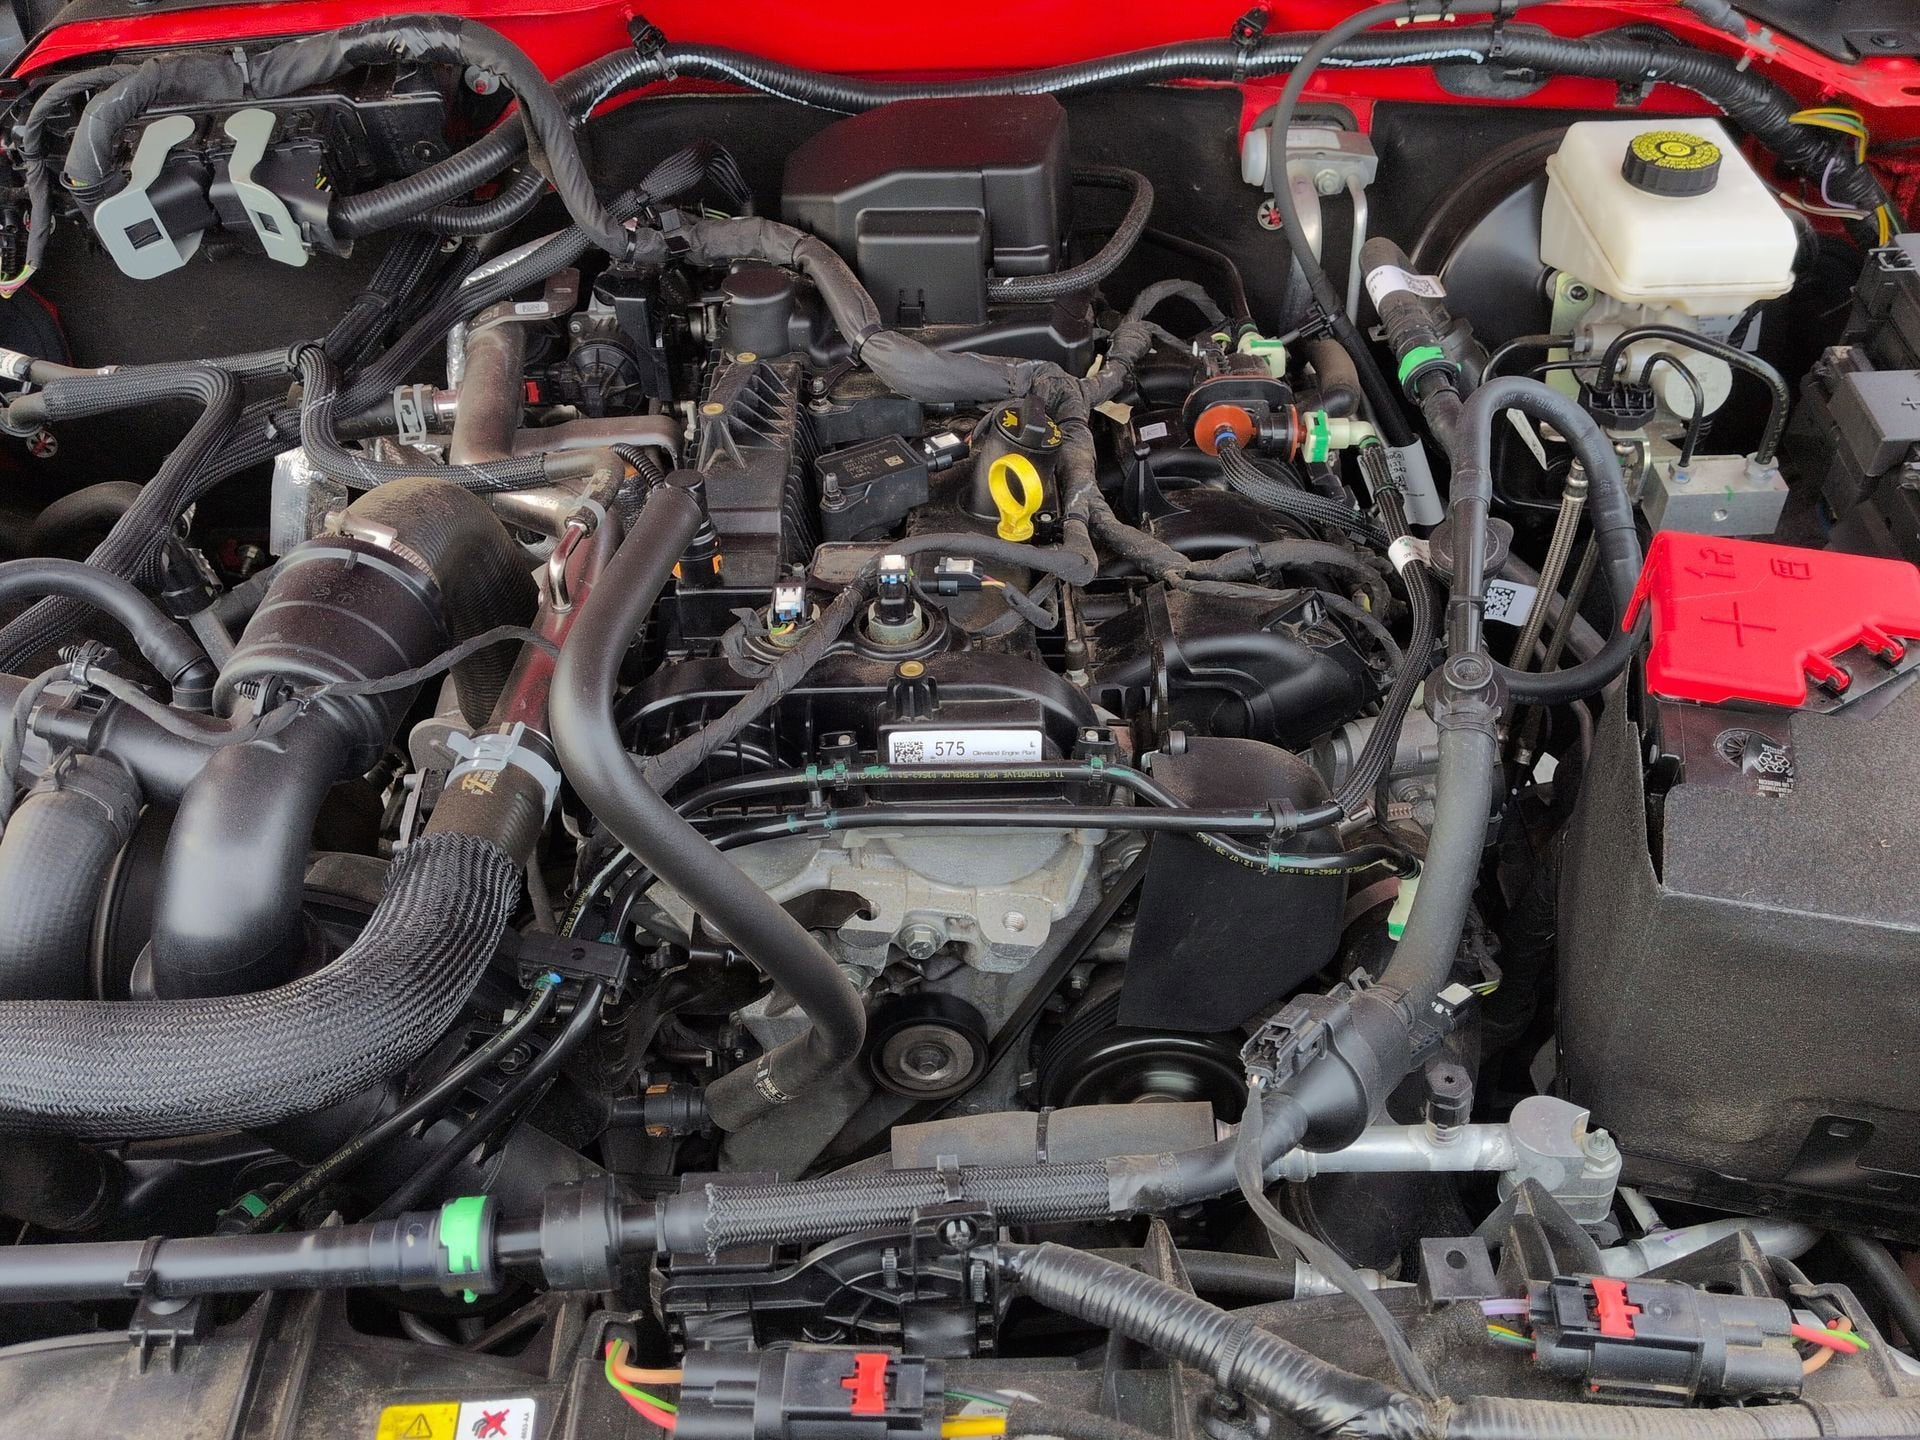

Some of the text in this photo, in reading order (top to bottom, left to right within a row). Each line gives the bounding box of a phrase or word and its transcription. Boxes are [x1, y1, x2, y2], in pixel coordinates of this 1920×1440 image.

[935, 741, 965, 757] 575
[972, 749, 1037, 758] Cleveland Engine Plant
[1003, 770, 1050, 779] AUTOMOTIVE
[1055, 771, 1065, 779] TI
[311, 1147, 352, 1178] AUTOMOTIVE
